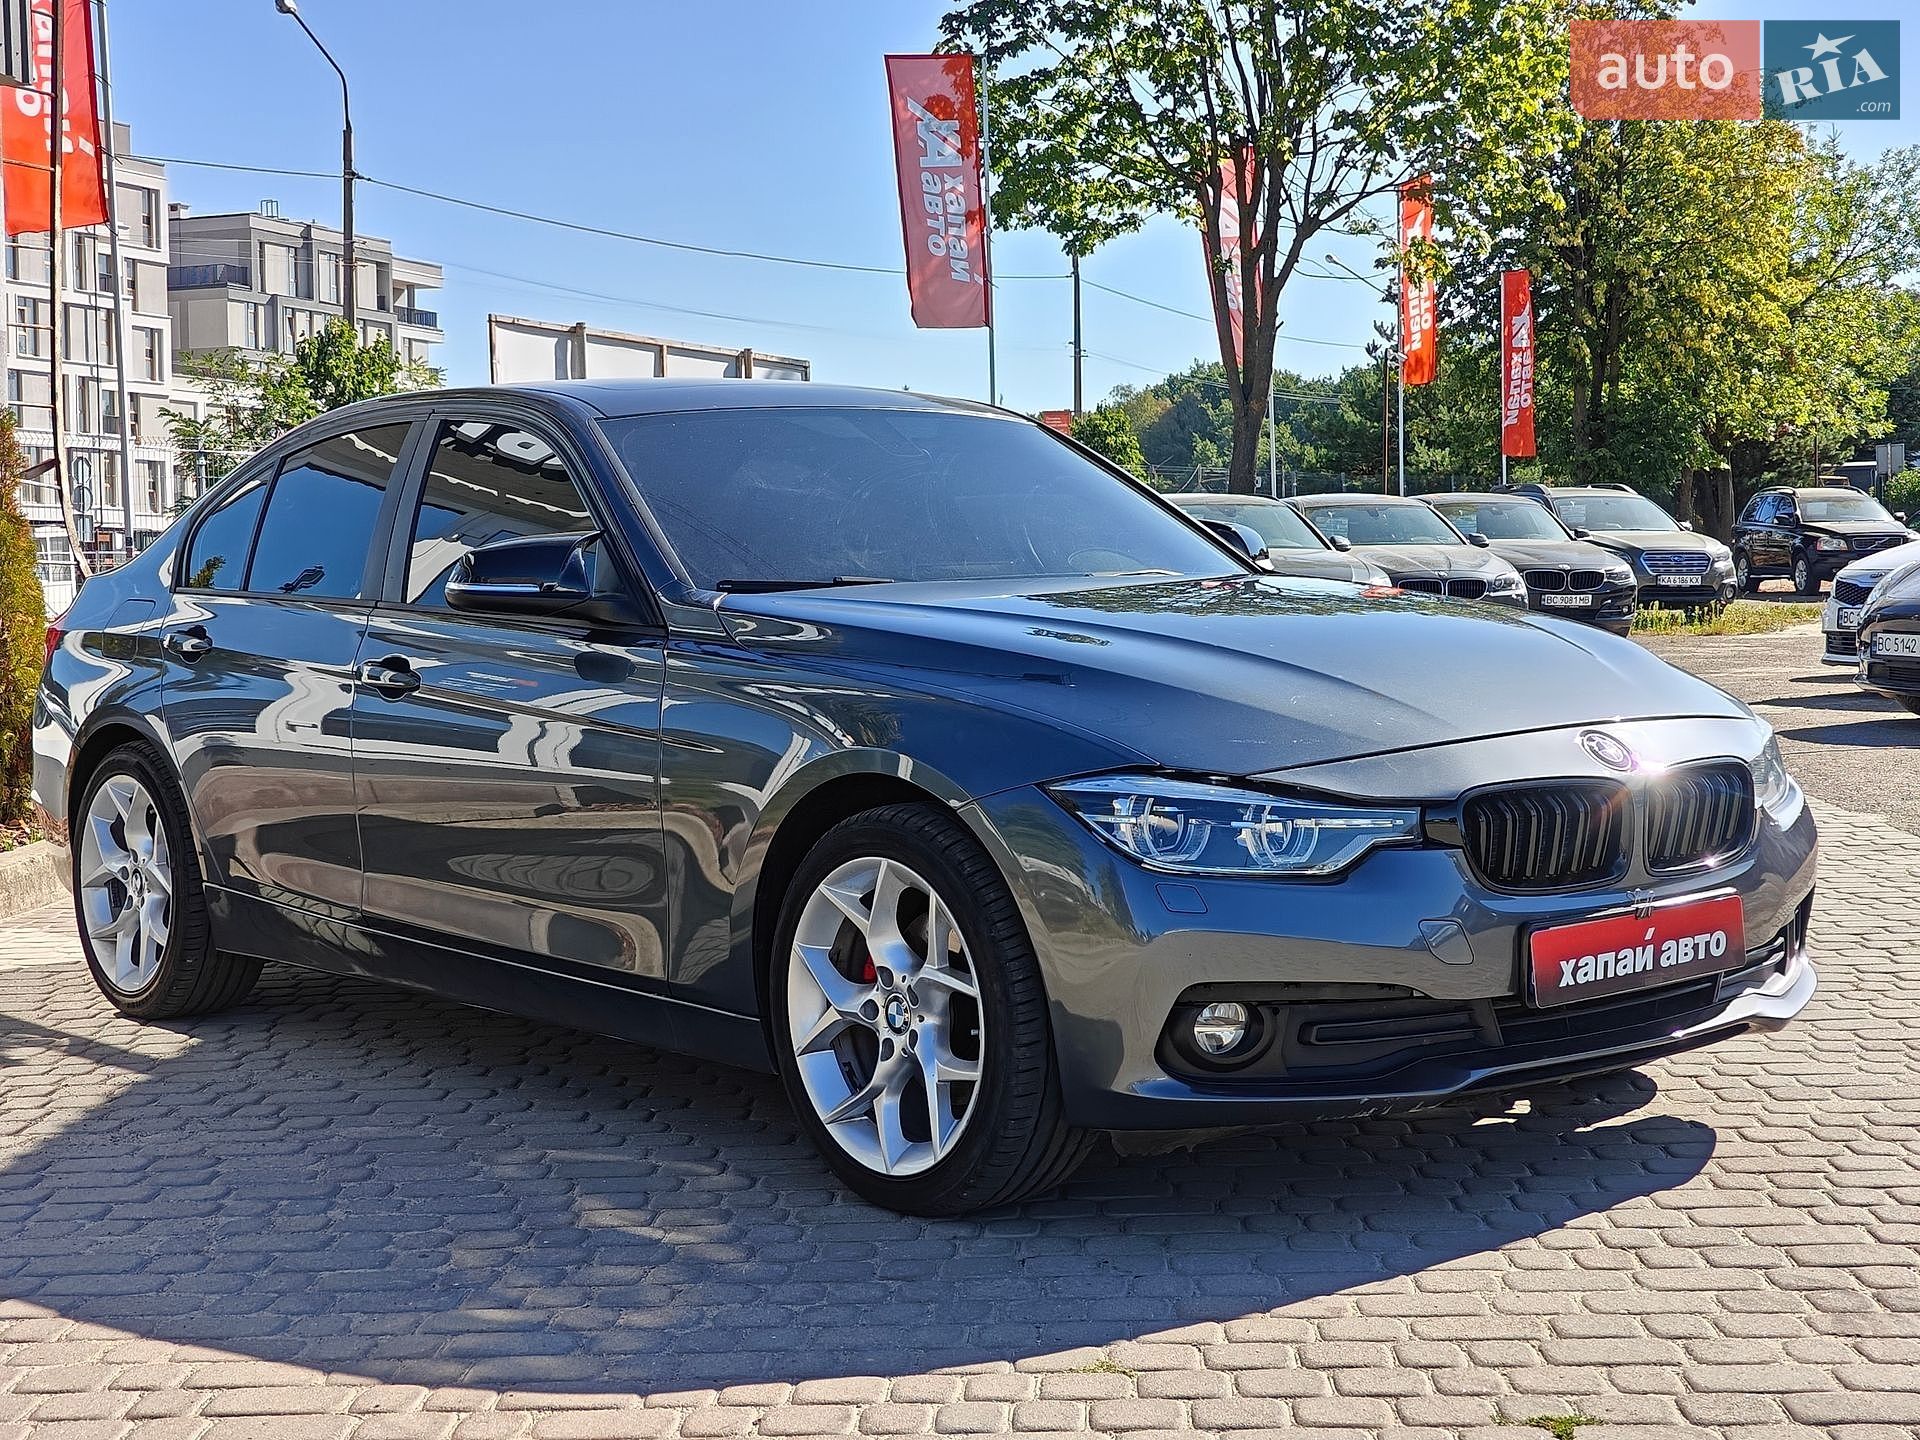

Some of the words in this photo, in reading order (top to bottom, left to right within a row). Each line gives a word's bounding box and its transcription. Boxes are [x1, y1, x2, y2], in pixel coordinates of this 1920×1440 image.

[920, 170, 947, 257] авто
[943, 172, 983, 286] хапай
[1877, 637, 1891, 652] BC
[1894, 637, 1917, 653] 5142
[1661, 929, 1727, 968] авто
